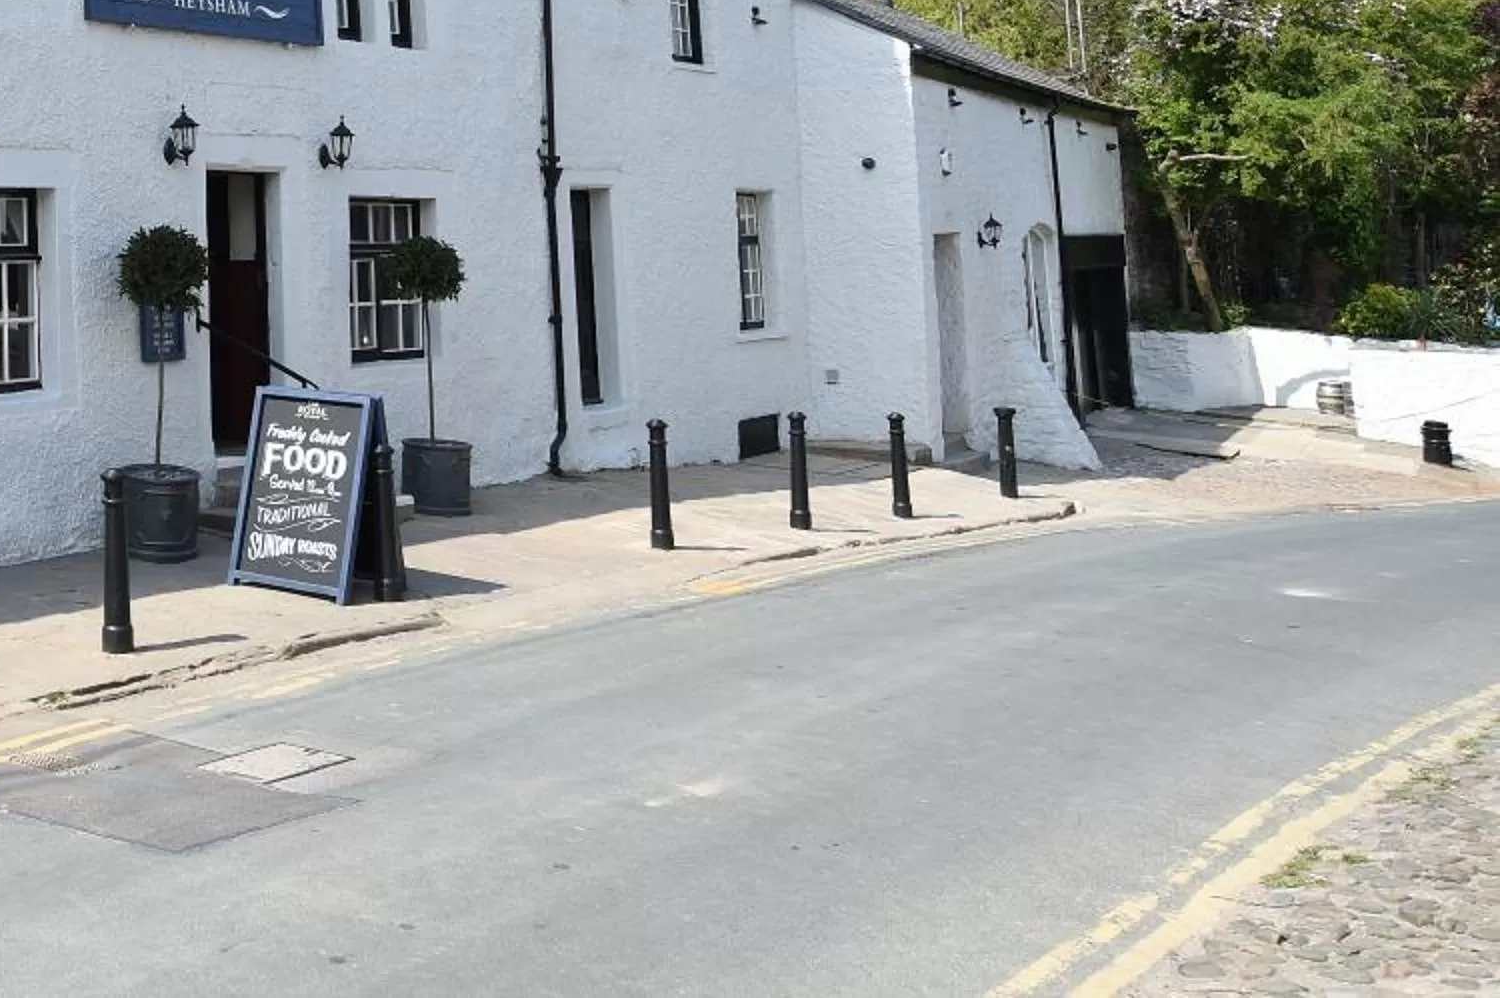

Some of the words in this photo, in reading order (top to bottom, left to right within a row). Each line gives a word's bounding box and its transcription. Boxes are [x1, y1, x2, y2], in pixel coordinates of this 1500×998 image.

[262, 442, 347, 480] FOOD
[257, 502, 332, 524] TRADITIONAL
[247, 532, 297, 561] SUNDAY
[297, 539, 338, 561] ROASTS
